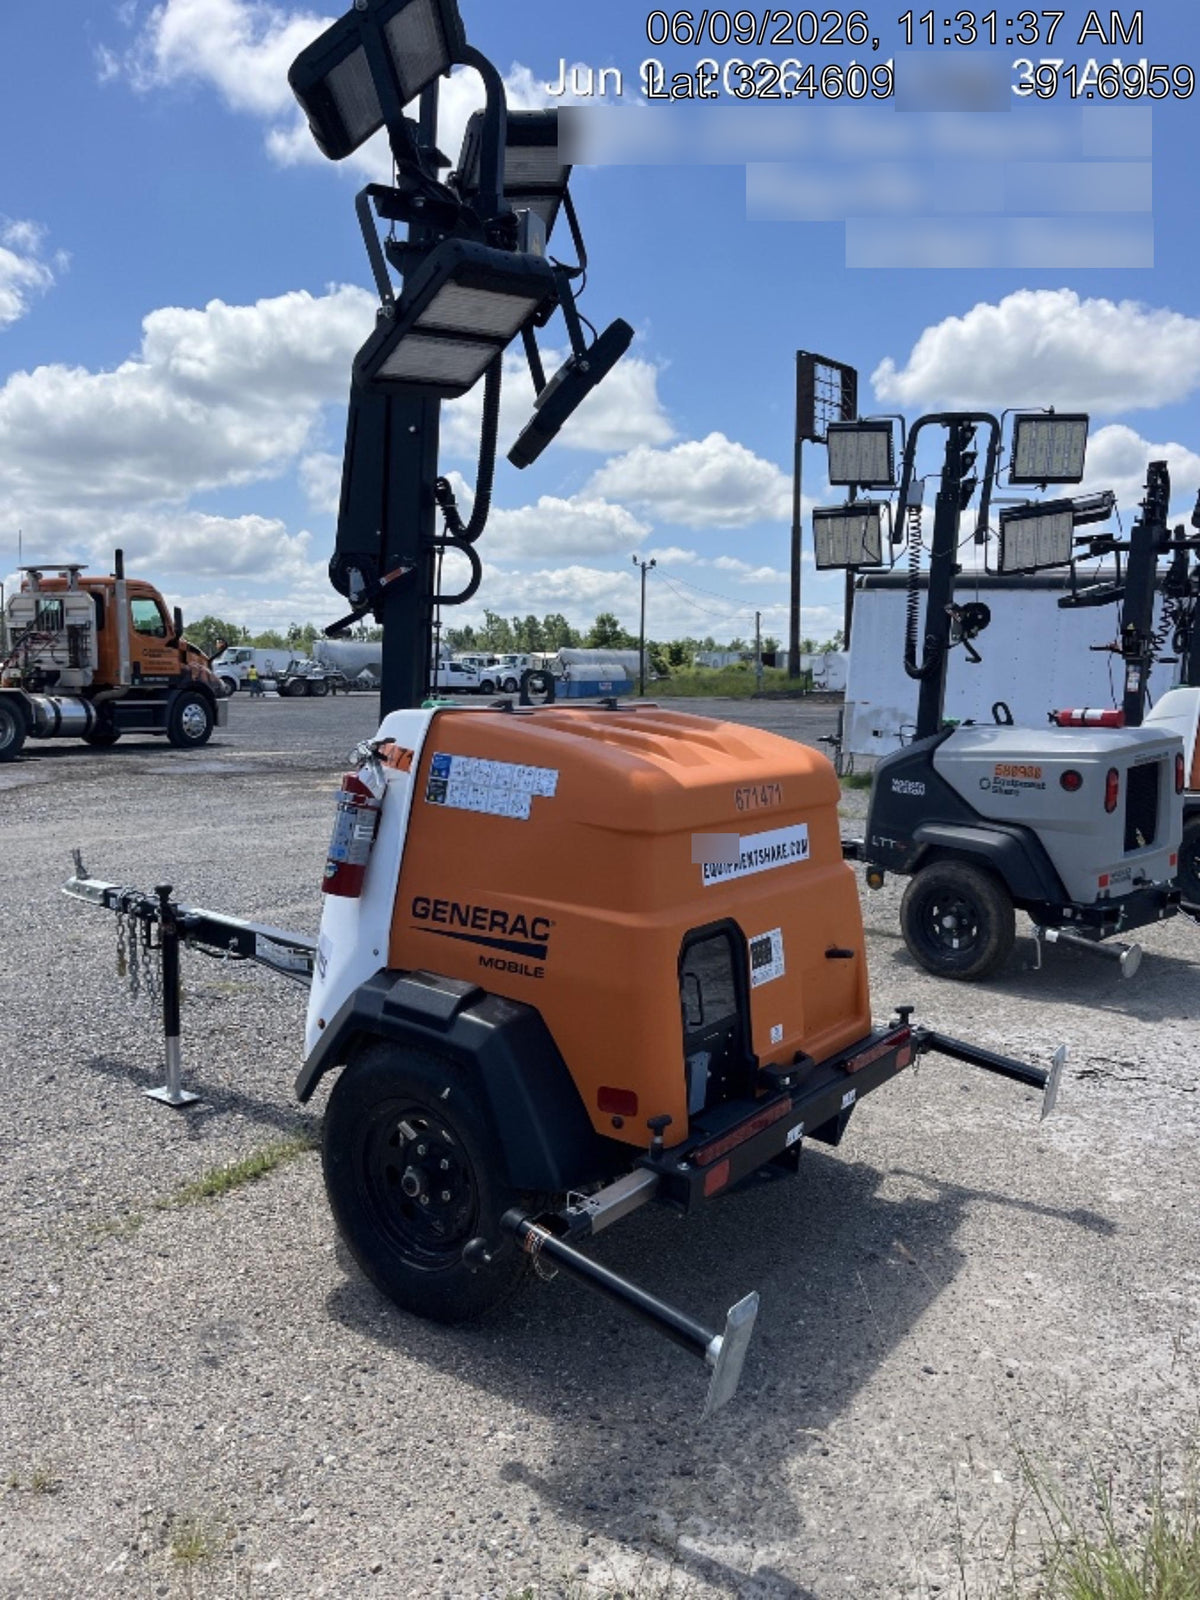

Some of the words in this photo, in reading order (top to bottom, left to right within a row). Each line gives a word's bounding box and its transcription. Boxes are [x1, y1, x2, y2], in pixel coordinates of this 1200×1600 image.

[734, 783, 782, 811] 671471
[411, 896, 551, 941] GENERAC
[478, 954, 545, 979] MOBILE
